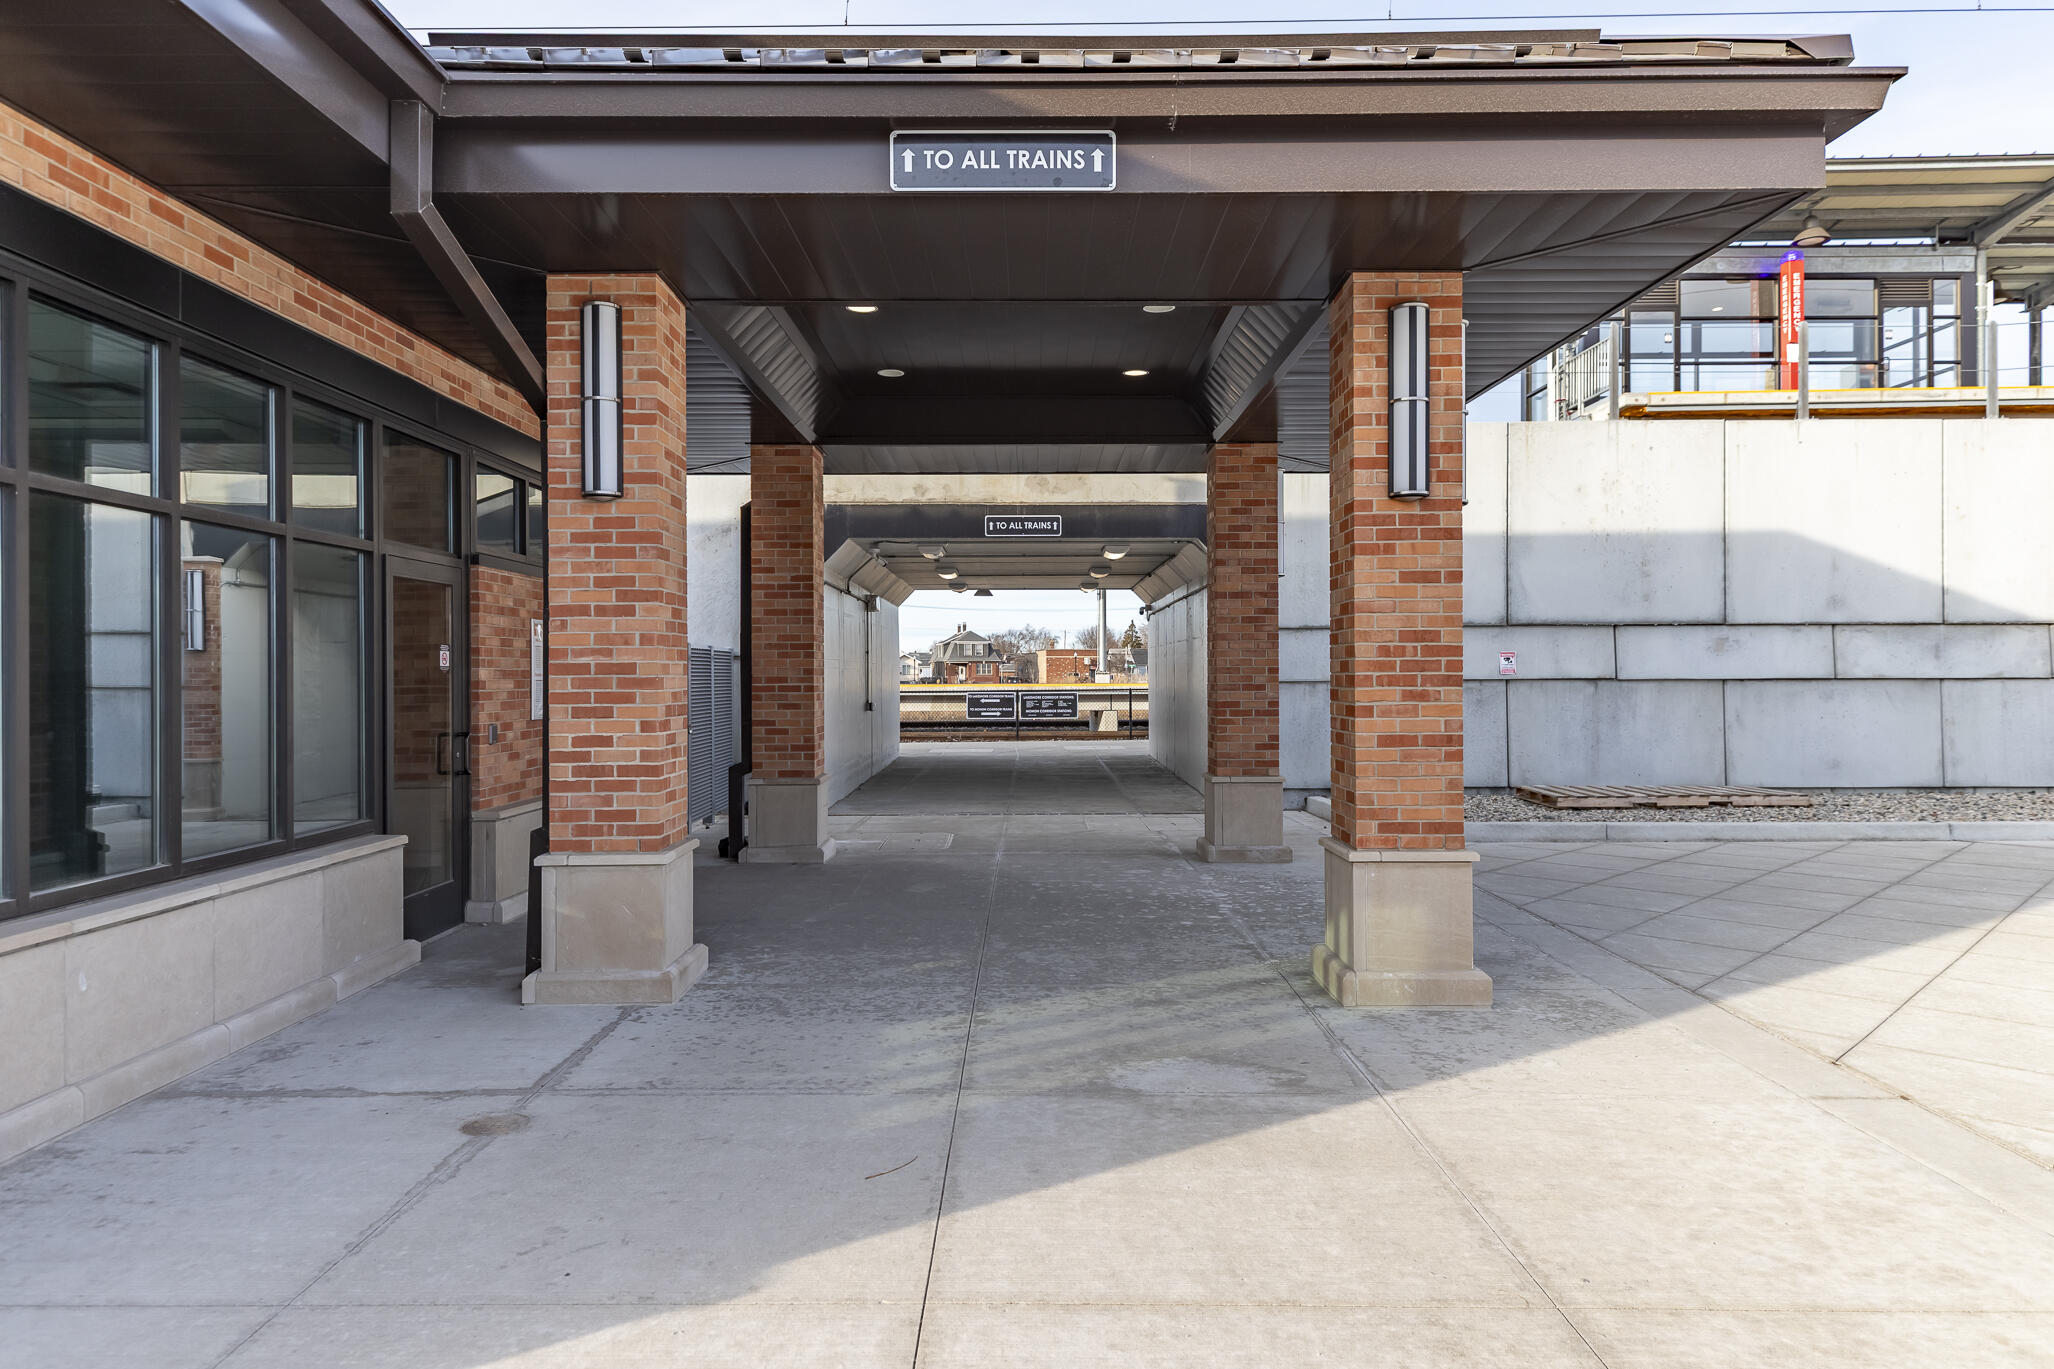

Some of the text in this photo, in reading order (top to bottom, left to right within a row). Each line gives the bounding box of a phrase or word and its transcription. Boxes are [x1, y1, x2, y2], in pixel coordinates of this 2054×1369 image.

[924, 149, 1086, 170] TO ALL TRAINS
[996, 521, 1052, 530] TO ALL TRAINS
